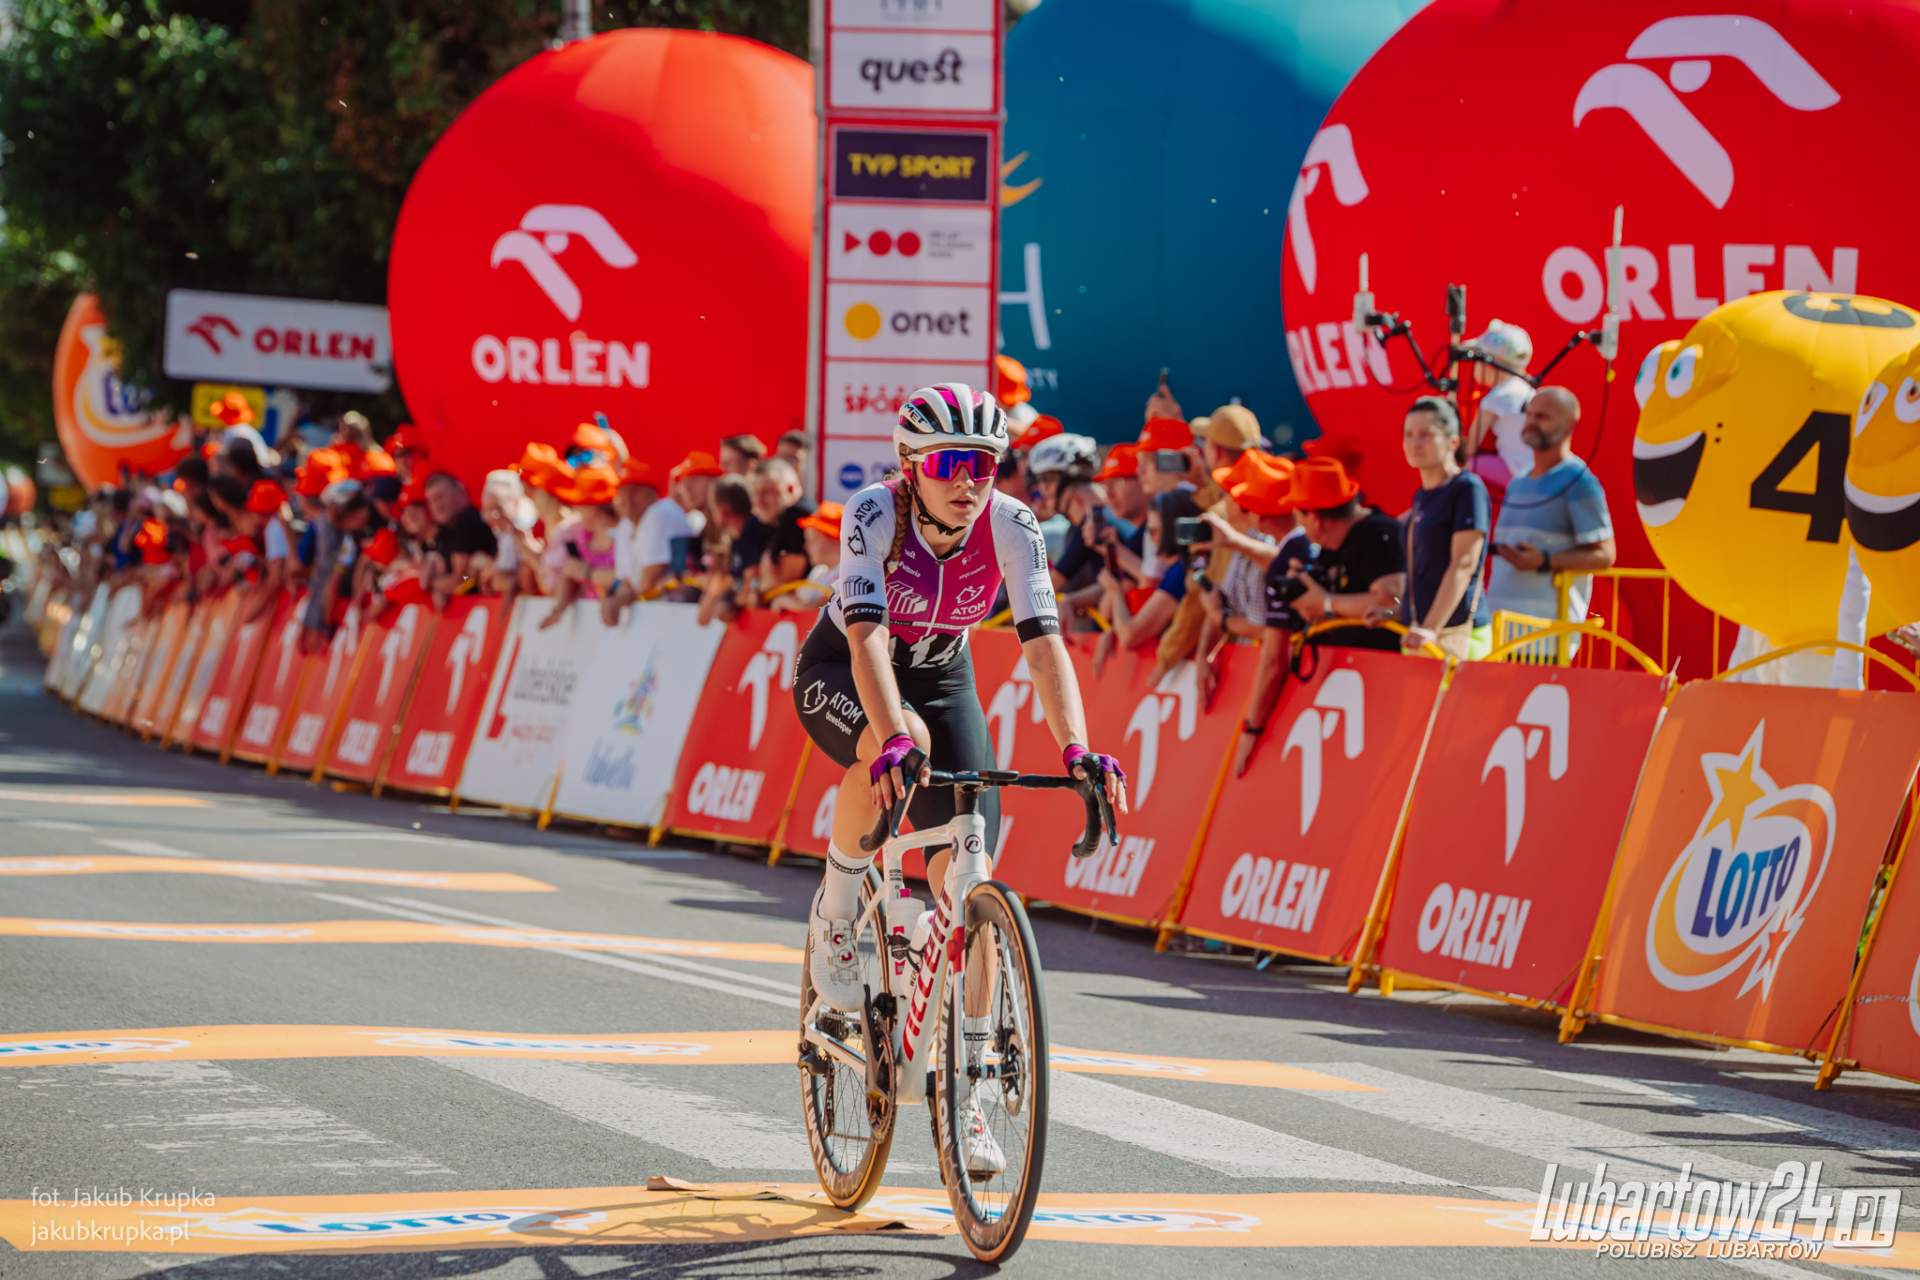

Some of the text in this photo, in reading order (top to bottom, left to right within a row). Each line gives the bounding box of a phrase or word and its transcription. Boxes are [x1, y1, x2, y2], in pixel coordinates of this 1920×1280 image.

[861, 48, 962, 93] quest
[849, 153, 975, 179] TVP SPORT
[891, 306, 971, 335] onet
[253, 327, 375, 361] ORLEN
[471, 334, 650, 389] ORLEN
[903, 403, 928, 425] MET
[1750, 410, 1852, 544] 4
[854, 498, 879, 523] ATOM
[952, 600, 986, 616] ATOM
[828, 691, 864, 724] ATOM
[686, 761, 767, 823] ORLEN
[1219, 852, 1331, 934] ORLEN
[1690, 835, 1801, 939] LOTTO
[1416, 882, 1531, 970] ORLEN
[254, 1212, 511, 1233] LOTTO
